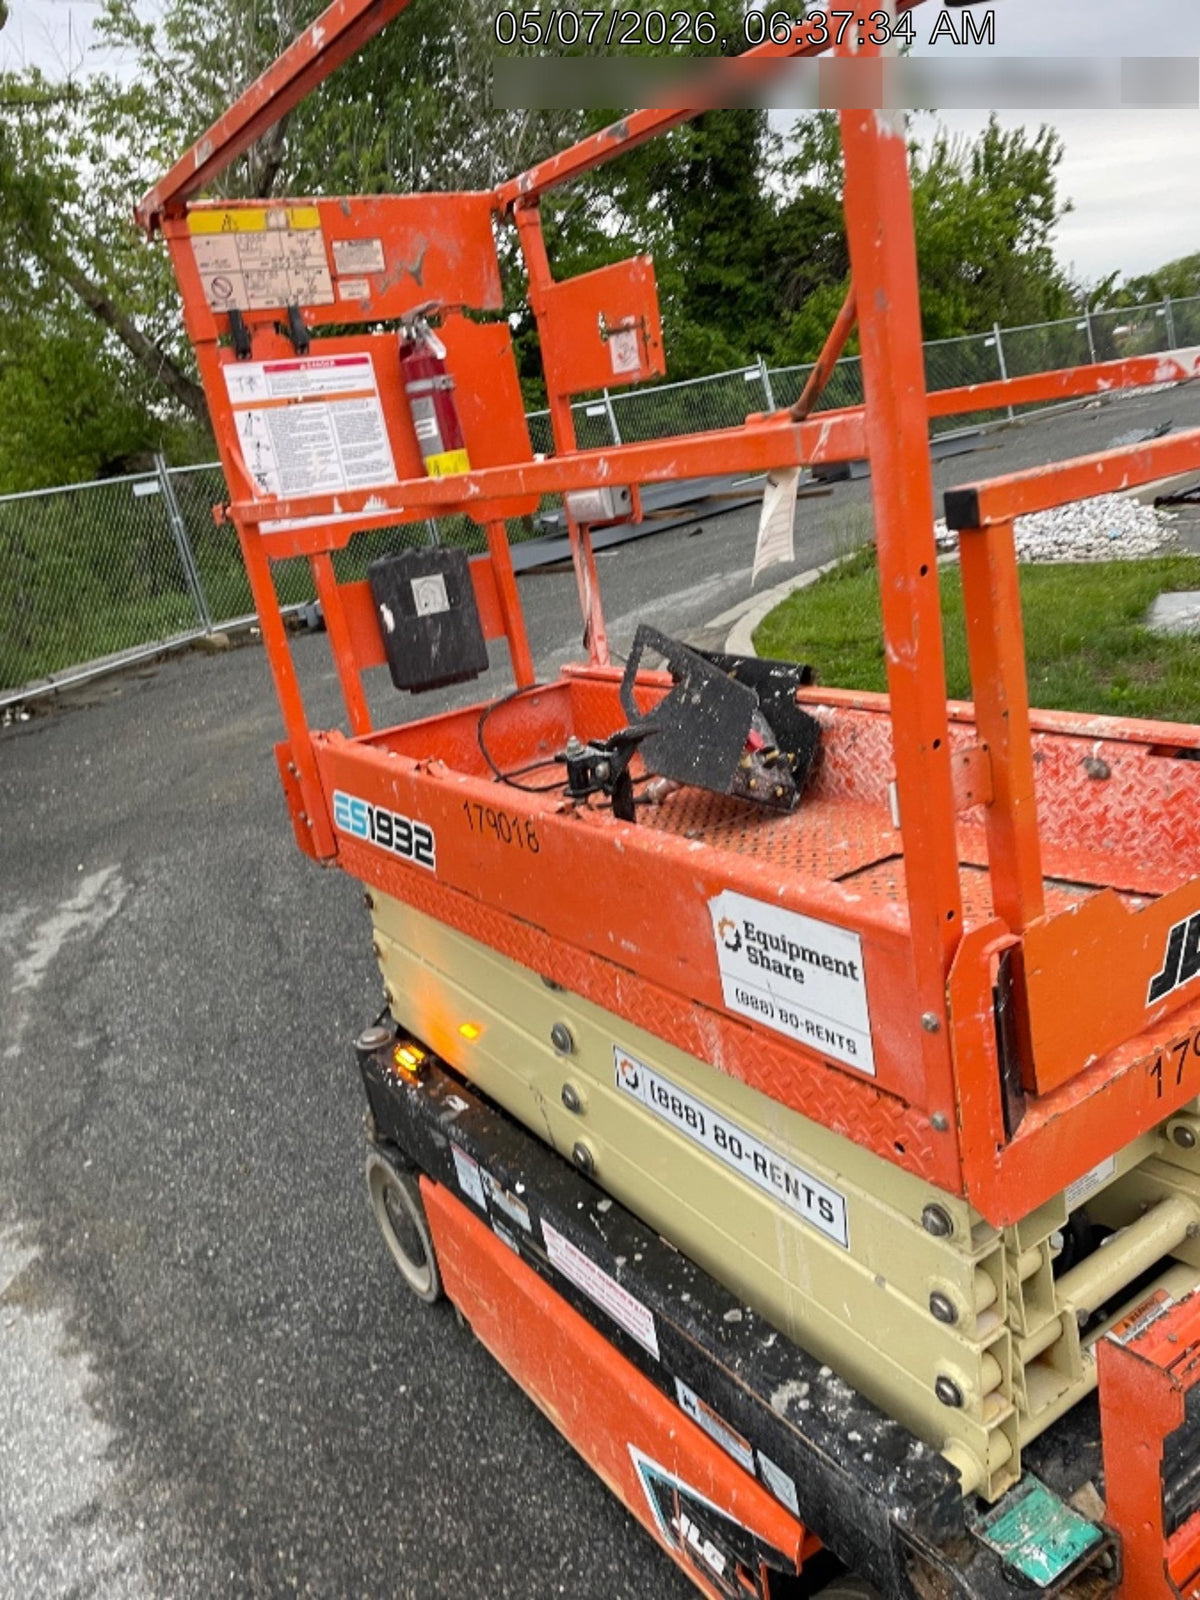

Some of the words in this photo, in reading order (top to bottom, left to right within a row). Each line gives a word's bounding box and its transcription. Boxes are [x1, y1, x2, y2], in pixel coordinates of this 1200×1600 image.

[333, 790, 435, 871] ES1932
[463, 800, 540, 854] 179018
[742, 920, 860, 982] Equipment
[746, 944, 805, 984] Share
[735, 987, 775, 1019] (888)
[778, 1008, 858, 1055] 80-RENTS
[650, 1079, 706, 1136] (888)
[713, 1124, 835, 1223] 80-RENTS
